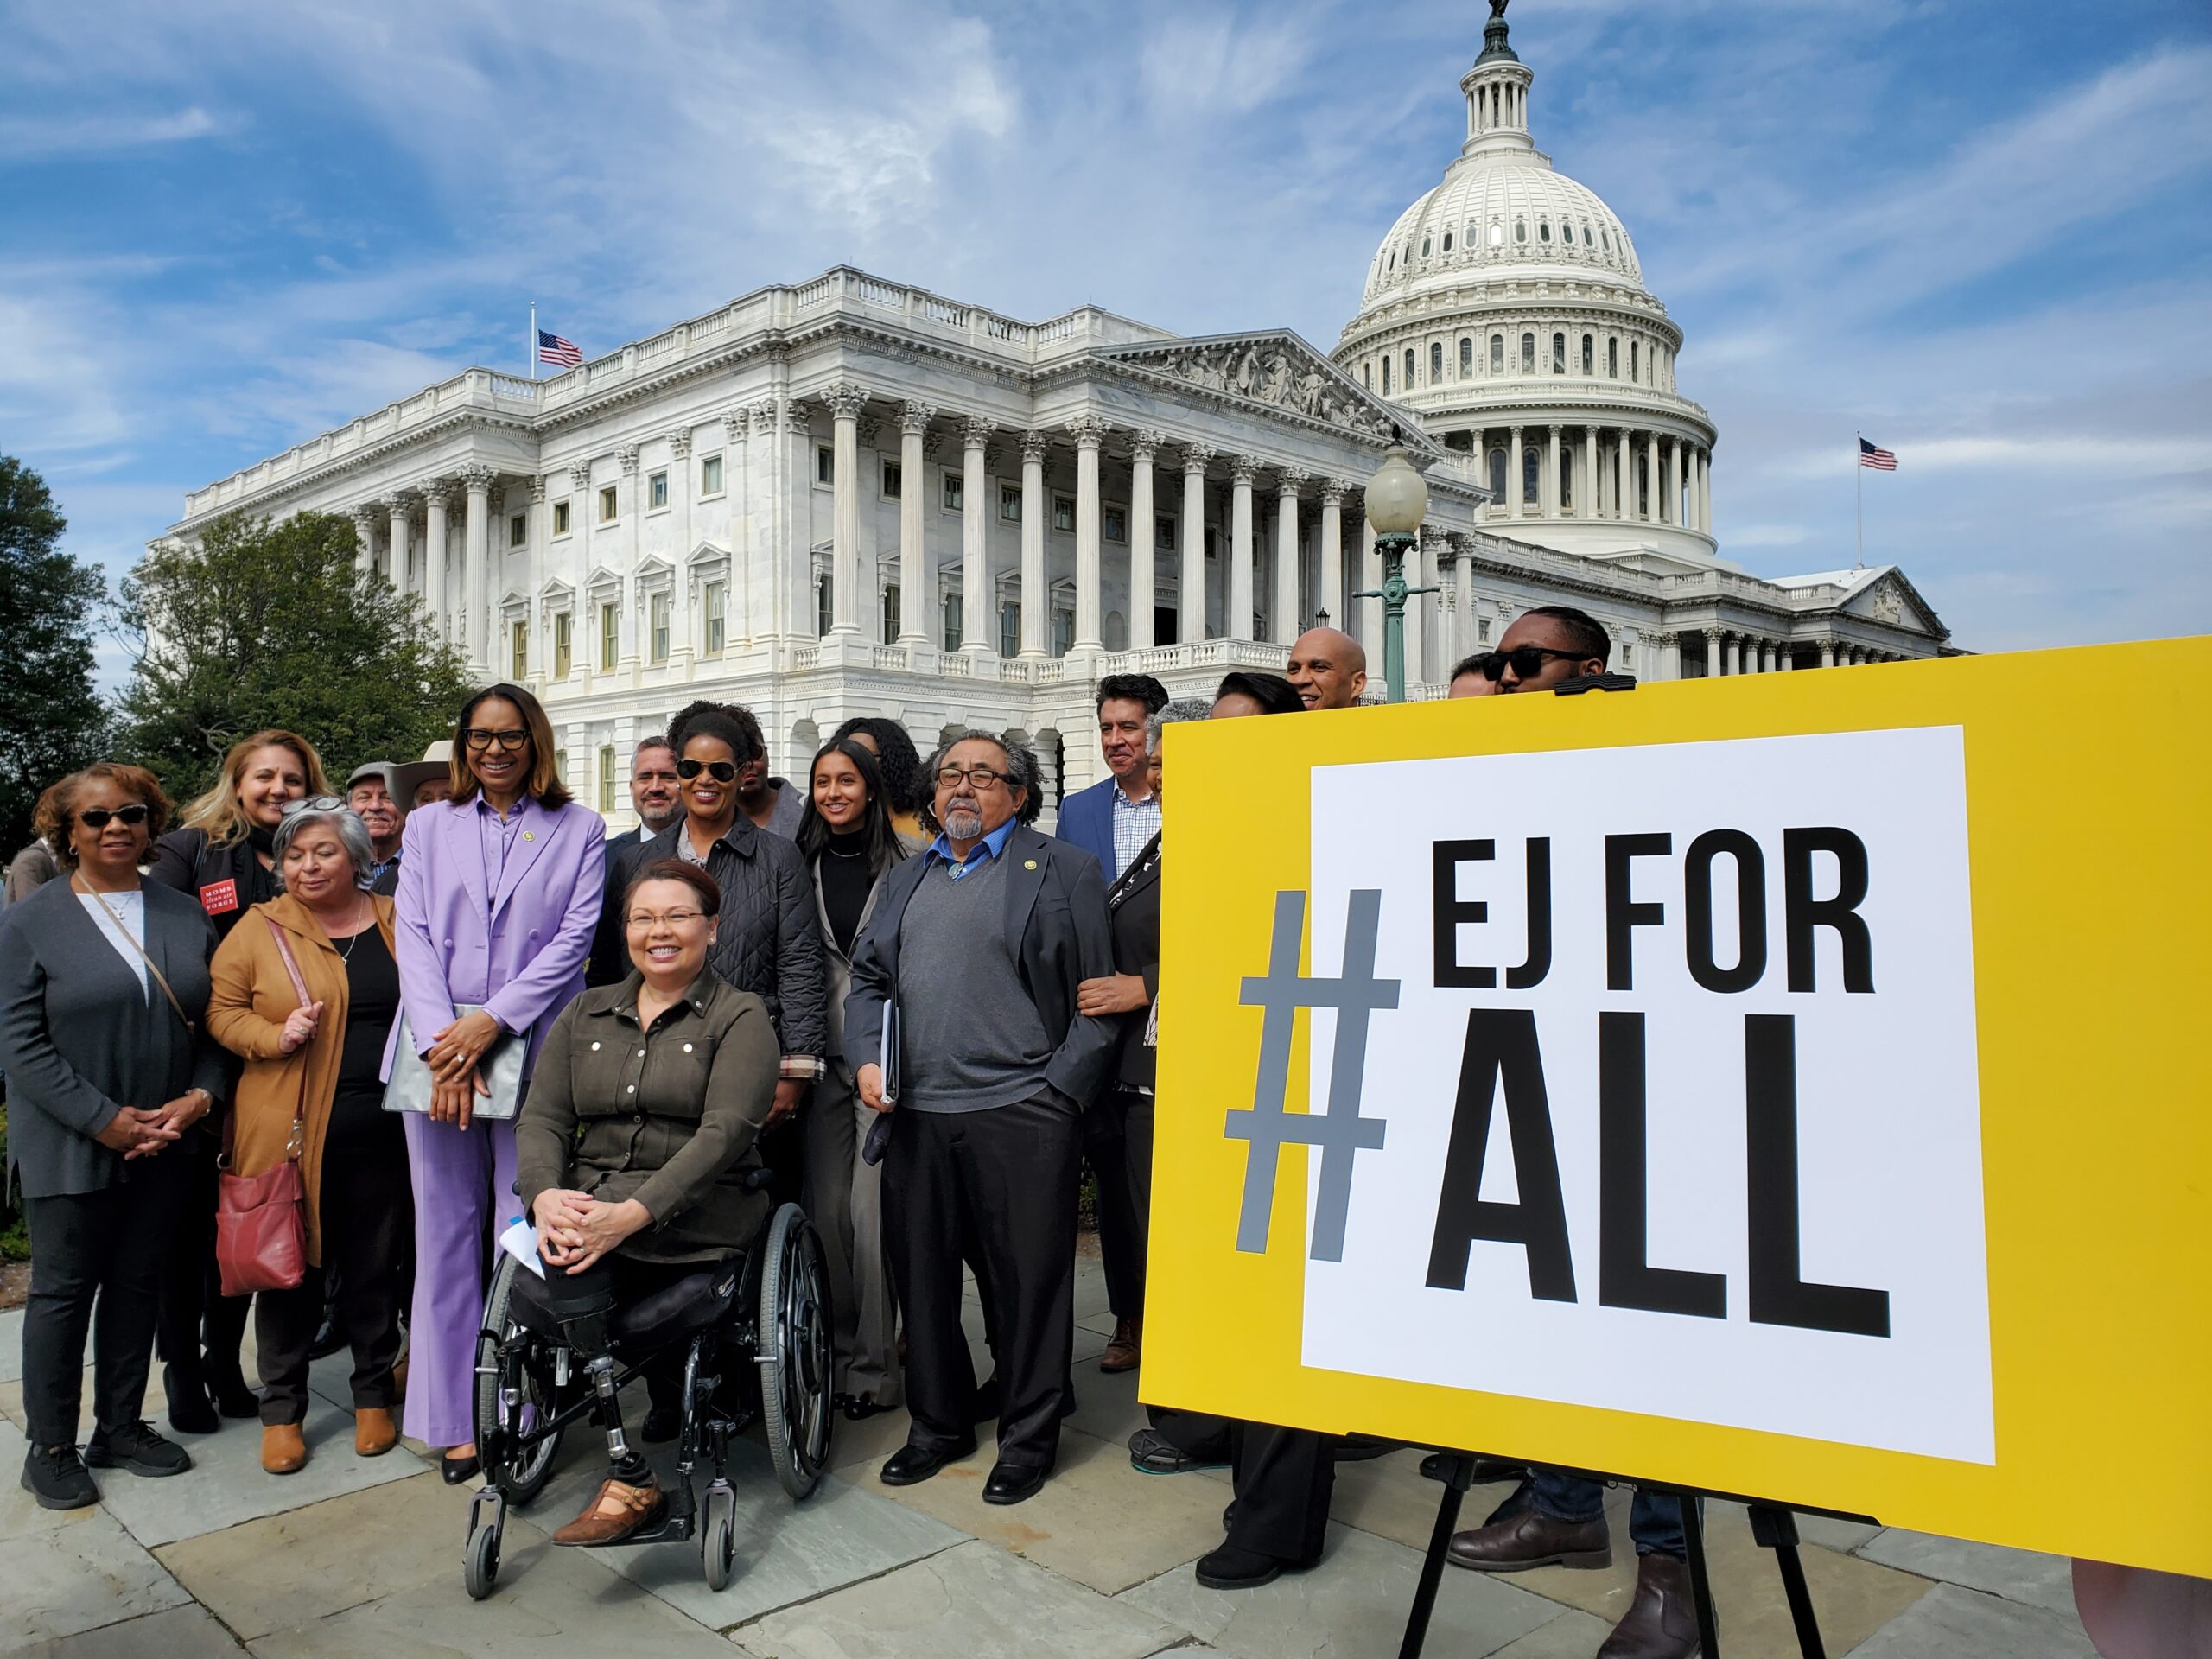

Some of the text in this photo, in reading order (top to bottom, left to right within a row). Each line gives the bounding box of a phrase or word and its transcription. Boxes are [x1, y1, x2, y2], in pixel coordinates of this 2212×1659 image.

[206, 886, 232, 897] MOMS
[207, 899, 233, 910] FORCE
[1433, 827, 1876, 994] EJ FOR
[1426, 1007, 1891, 1338] ALL
